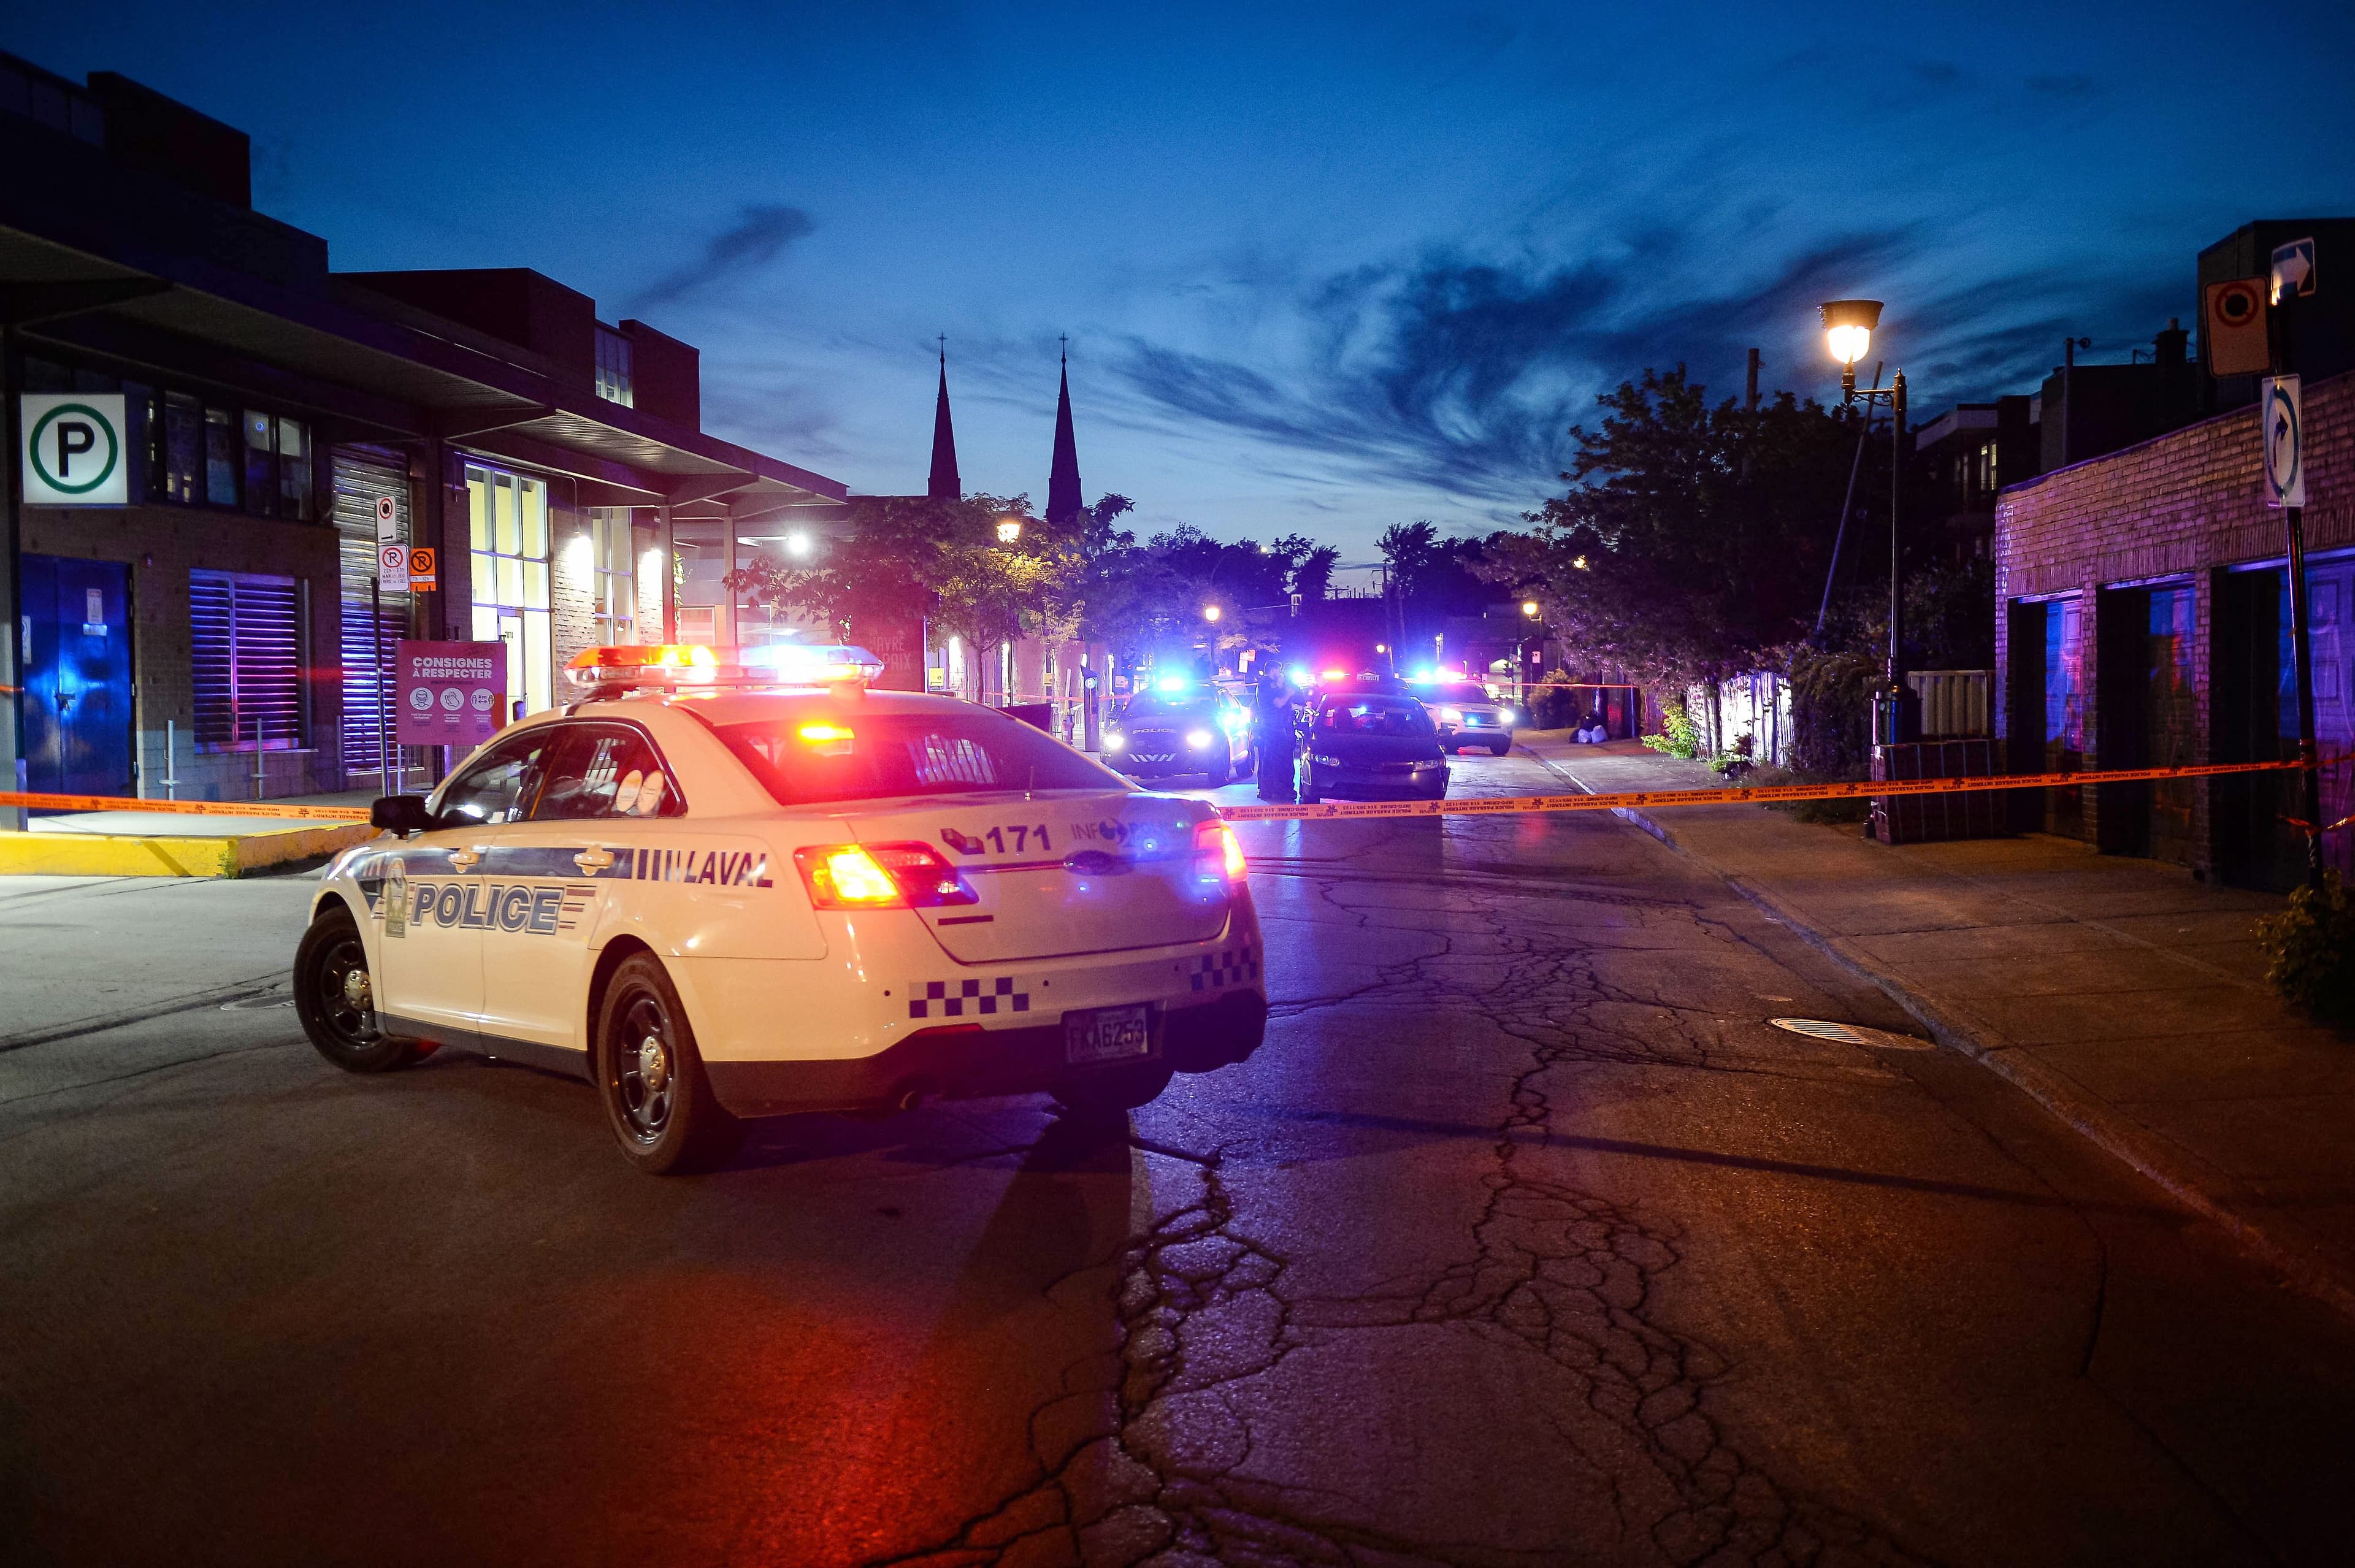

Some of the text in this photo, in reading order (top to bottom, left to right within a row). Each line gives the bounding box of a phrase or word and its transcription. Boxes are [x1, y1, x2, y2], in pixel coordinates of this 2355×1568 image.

[57, 422, 95, 477] P
[413, 657, 492, 668] CONSIGNES
[413, 668, 492, 678] À RESPECTER
[986, 824, 1051, 852] 171
[684, 851, 773, 888] LAVAL
[411, 883, 565, 936] POLICE
